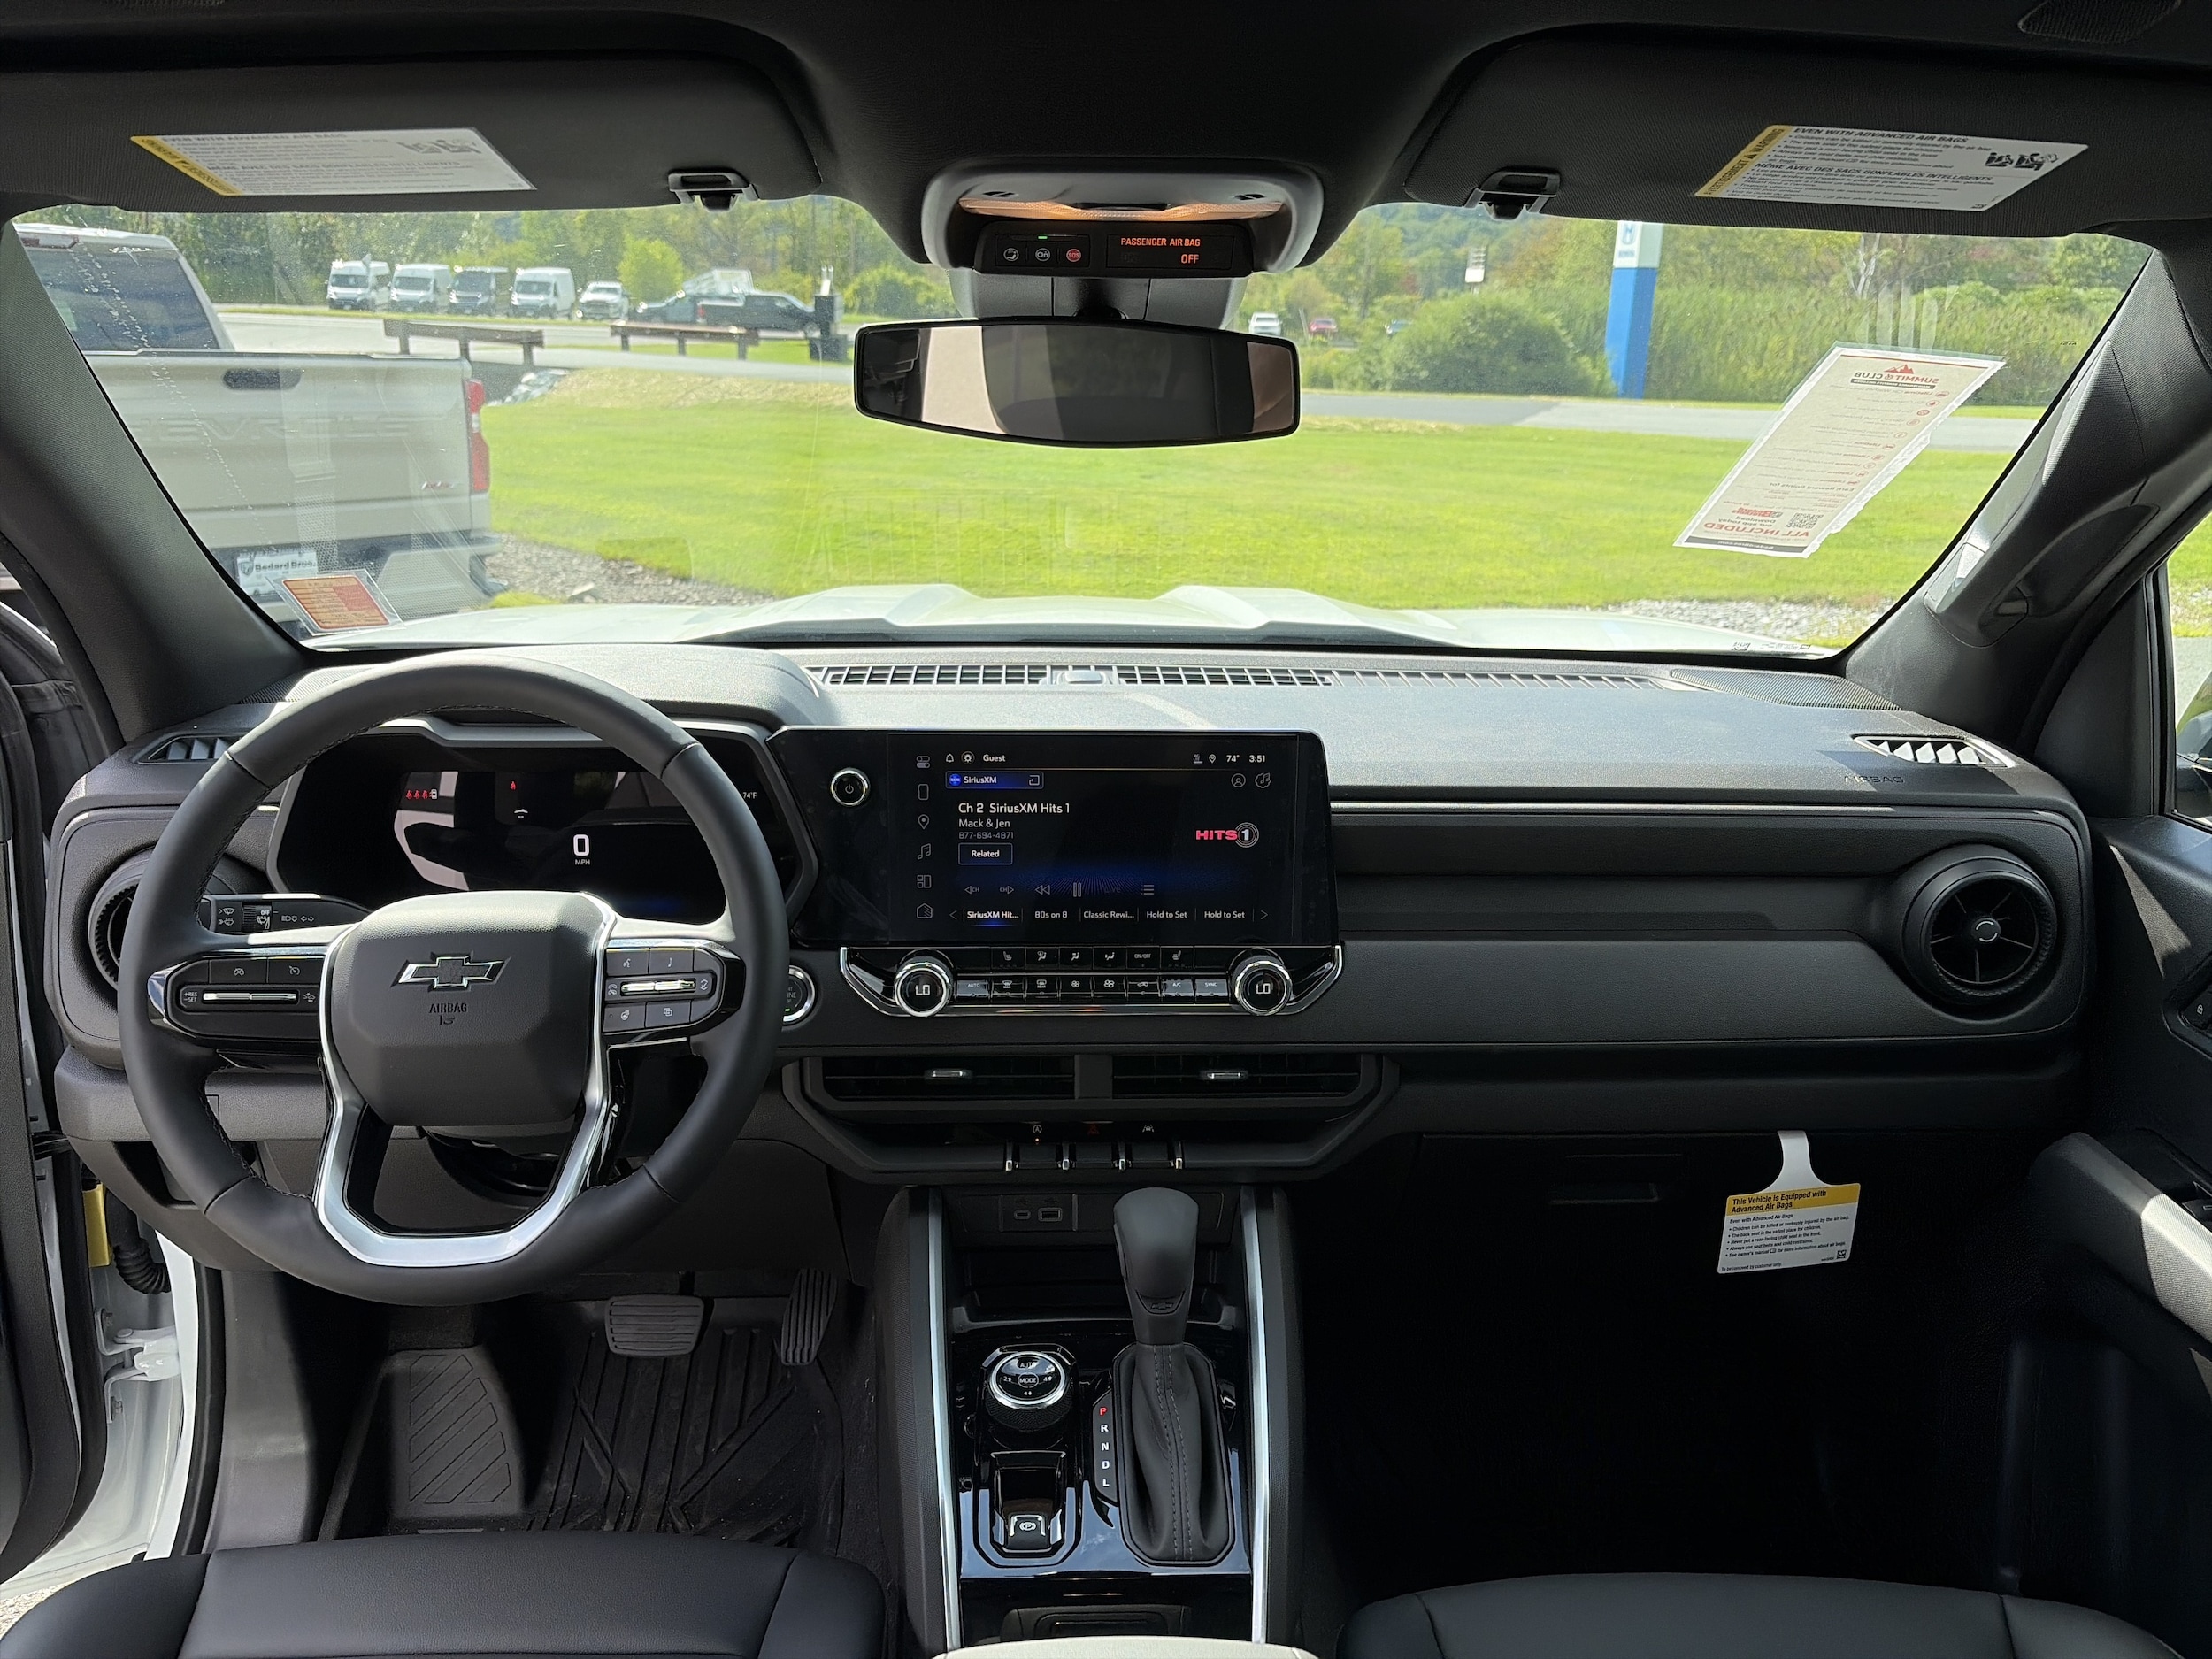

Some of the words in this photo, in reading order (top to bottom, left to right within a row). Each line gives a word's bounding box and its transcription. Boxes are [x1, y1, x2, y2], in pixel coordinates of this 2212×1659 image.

[1855, 131, 1915, 140] ADVANCED
[1120, 237, 1167, 246] PASSENGER
[1169, 238, 1184, 247] AIR
[1180, 254, 1199, 264] OFF
[255, 561, 290, 572] Bedard
[1226, 754, 1240, 763] 74°
[1248, 754, 1266, 763] 3:51
[964, 775, 997, 784] SiriusXM
[958, 803, 973, 814] Ch
[976, 803, 984, 814] 2
[989, 803, 1038, 814] SiriusXM
[1041, 803, 1063, 814] Hits
[1065, 803, 1071, 814] 1
[958, 818, 984, 828] Mack
[986, 818, 994, 828] &
[995, 818, 1010, 830] Jen
[958, 831, 1014, 840] 877-694-4871
[1195, 829, 1238, 841] HITS
[1241, 828, 1250, 841] 1
[573, 833, 590, 856] 0
[971, 849, 1000, 858] Related
[966, 910, 1001, 919] SiriusXM
[1034, 910, 1050, 919] 80s
[1062, 910, 1068, 919] 8
[1083, 910, 1109, 919] Classic
[1146, 910, 1164, 919] Hold
[1174, 910, 1187, 919] Set
[1204, 910, 1222, 919] Hold
[1233, 910, 1246, 919] Set
[428, 1002, 467, 1014] AIRBAG
[1748, 1195, 1772, 1204] Vehicle
[1780, 1191, 1811, 1202] Equipped
[1732, 1203, 1764, 1213] Advanced
[1099, 1407, 1107, 1416] P
[1100, 1424, 1110, 1433] R
[1101, 1442, 1110, 1451] N
[1102, 1460, 1110, 1470] D
[1102, 1478, 1110, 1487] L
